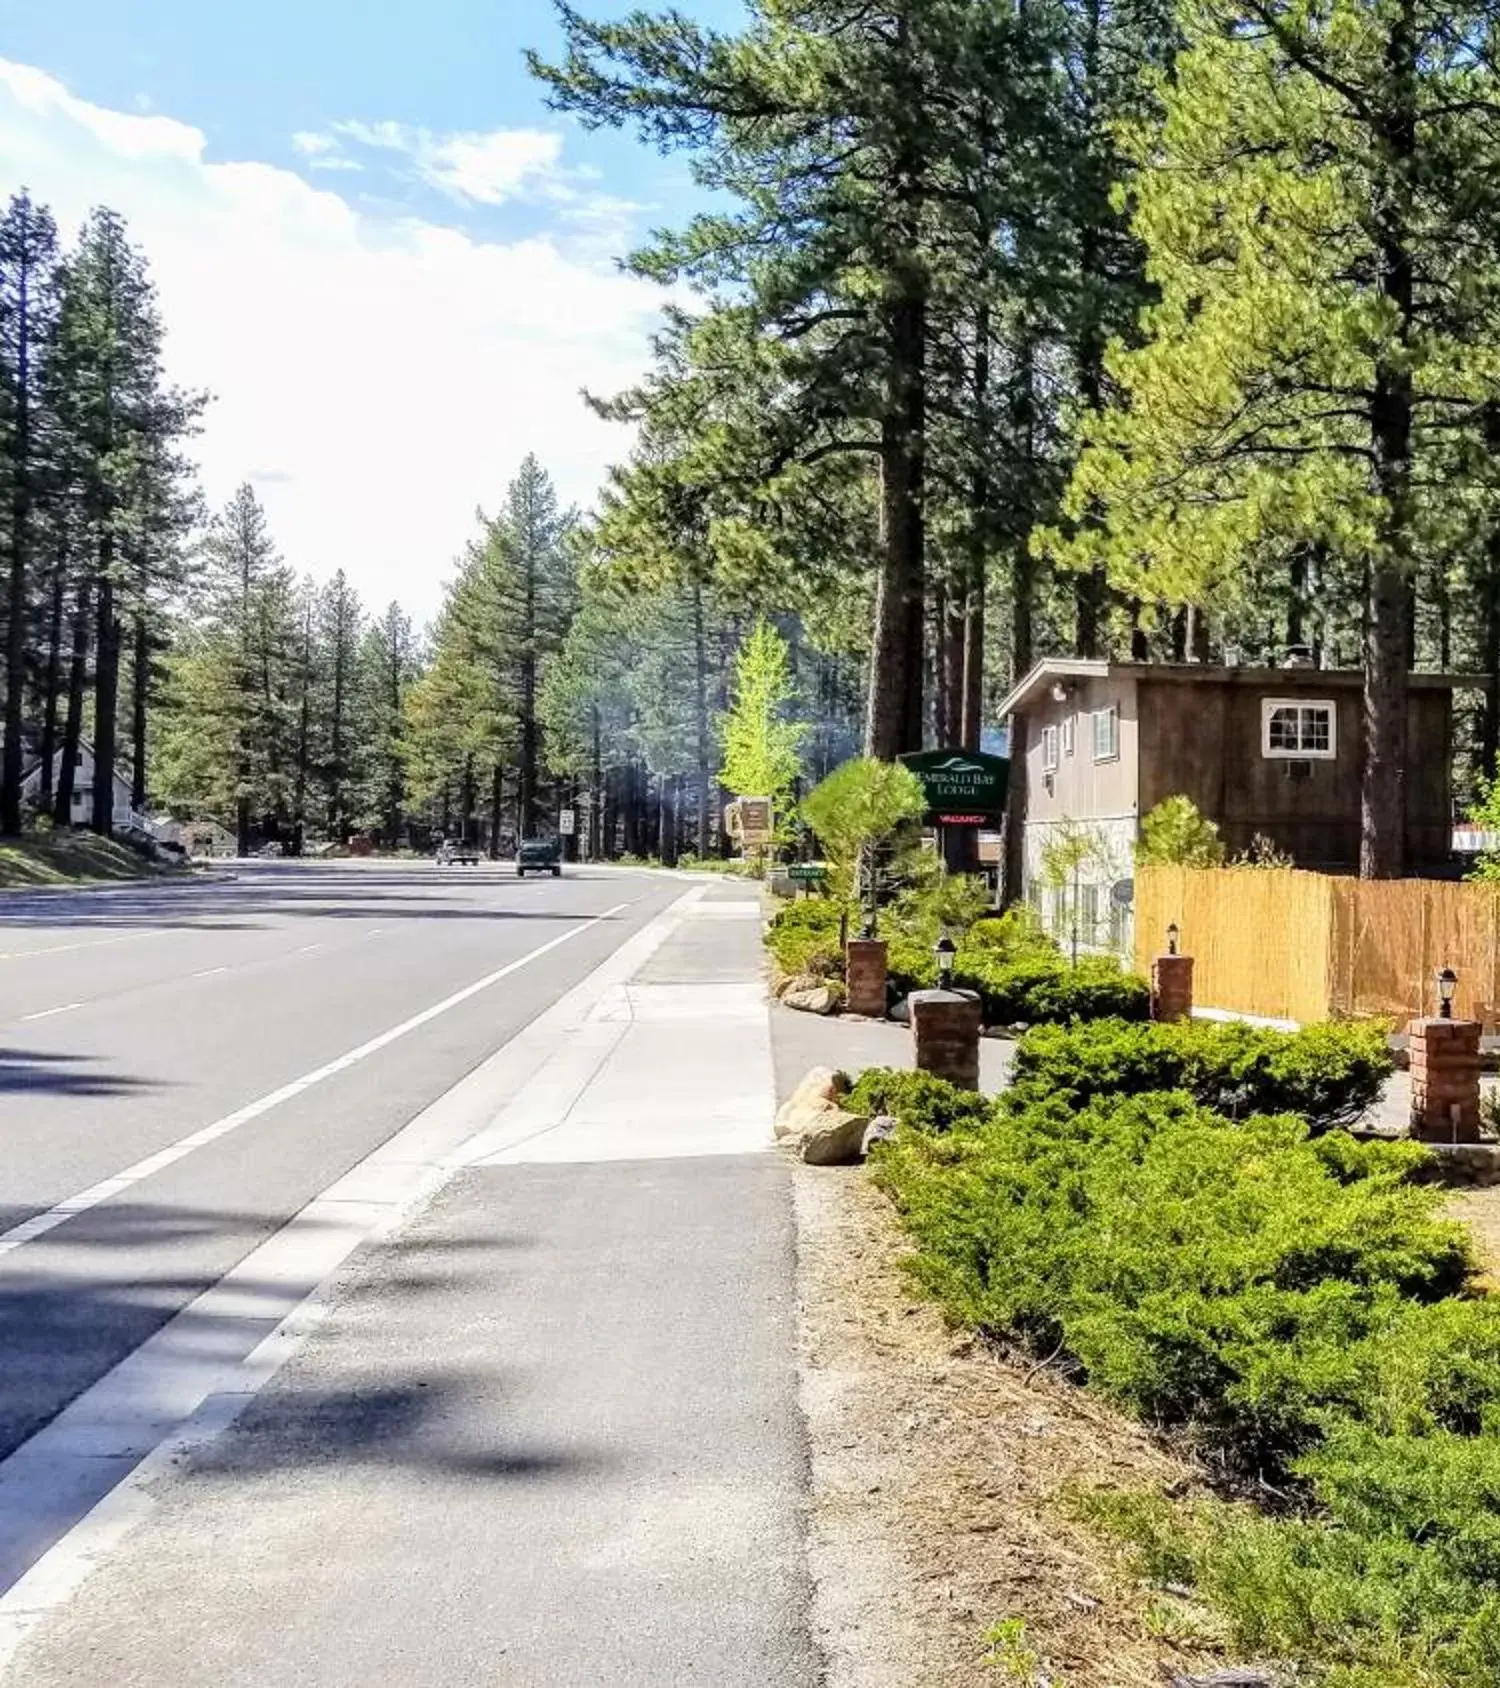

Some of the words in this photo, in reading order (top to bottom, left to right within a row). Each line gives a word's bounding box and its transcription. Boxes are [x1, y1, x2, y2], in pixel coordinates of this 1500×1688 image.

[915, 771, 970, 785] EMERALD
[973, 772, 995, 785] BAY
[937, 783, 979, 796] LODGE
[939, 815, 986, 824] VACANCY
